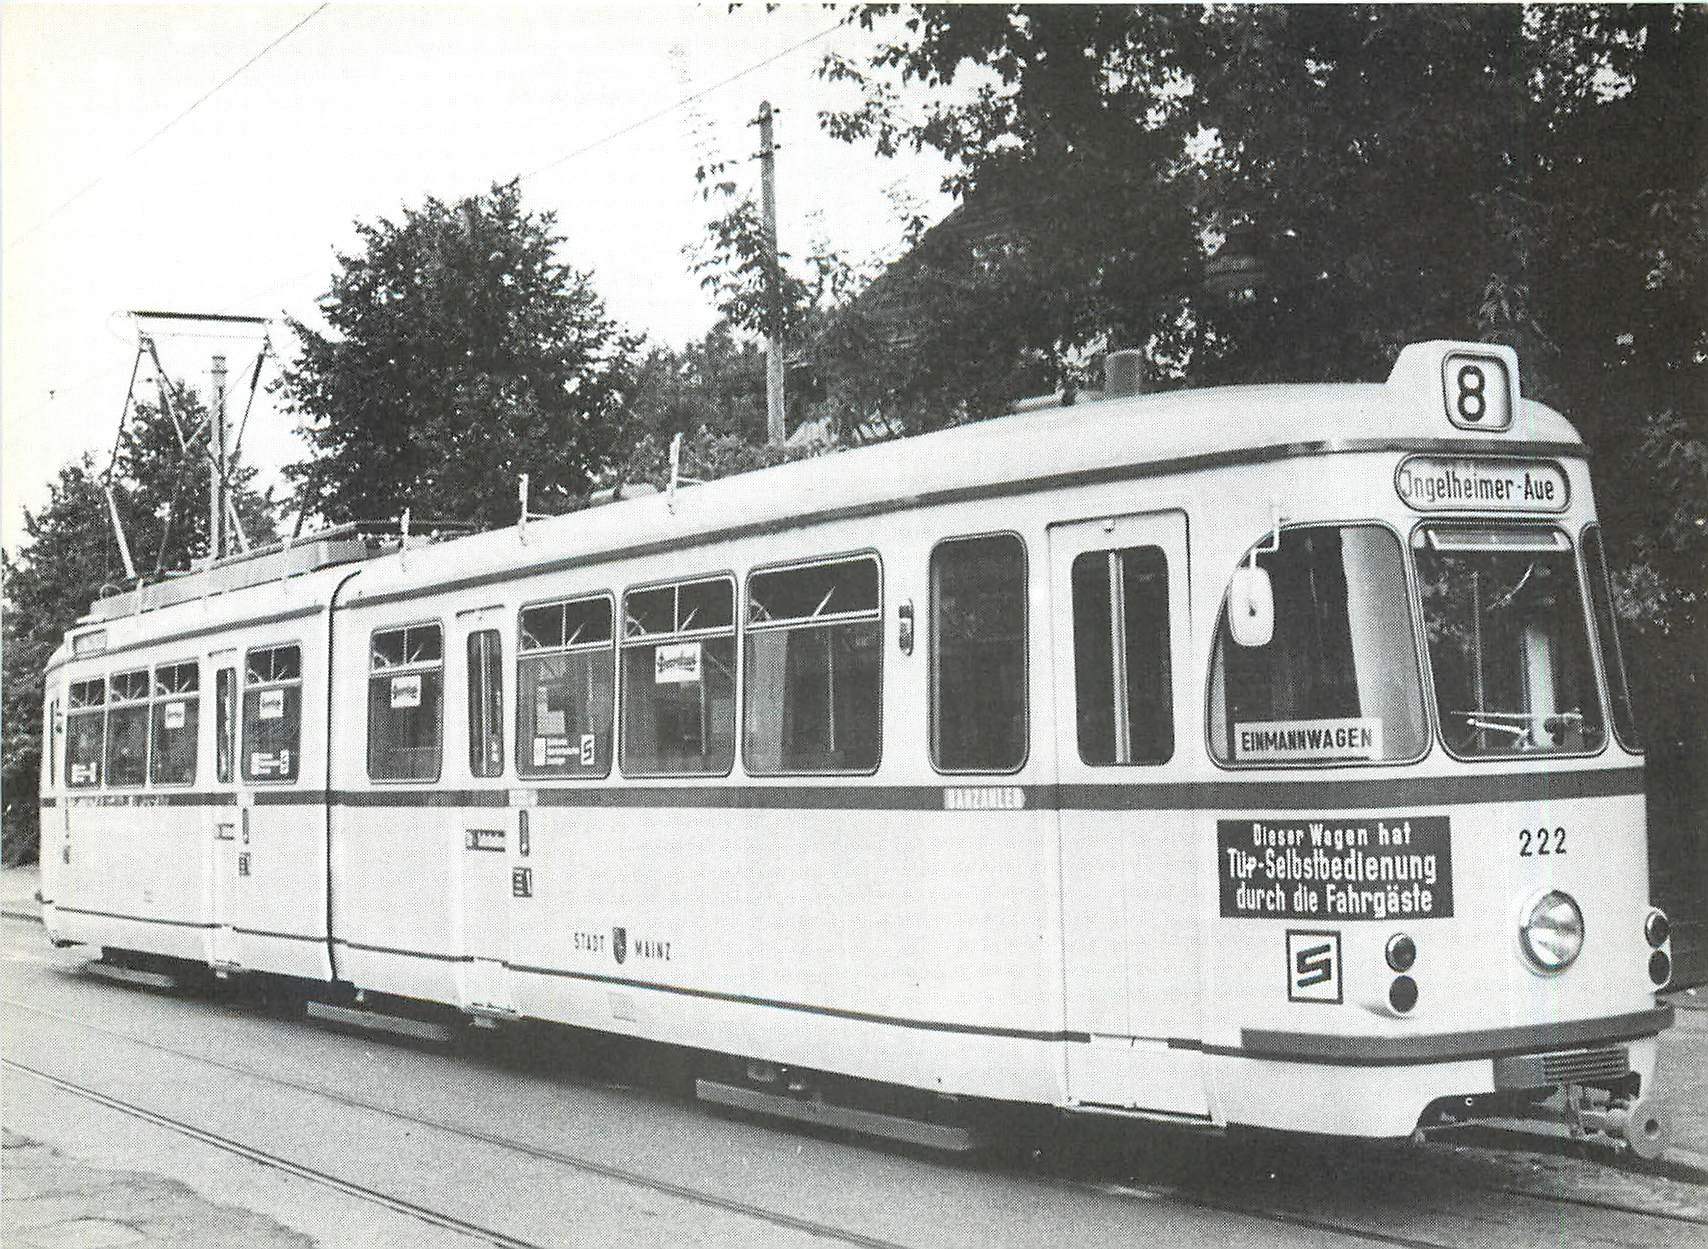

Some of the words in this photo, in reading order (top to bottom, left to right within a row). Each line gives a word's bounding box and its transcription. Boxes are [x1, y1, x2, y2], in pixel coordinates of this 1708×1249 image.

[1457, 365, 1486, 422] 8
[1241, 727, 1372, 752] EINMANNWAGEN
[1253, 823, 1304, 847] Dieser
[1309, 823, 1368, 850] Wagen
[1378, 821, 1412, 846] hat
[1519, 826, 1567, 857] 222
[1227, 847, 1437, 884] Tür-Selbstbedienung
[1236, 881, 1286, 911] durch
[1293, 883, 1319, 912] die
[1326, 882, 1433, 918] Fahrgäste
[574, 931, 605, 953] STADT
[634, 939, 672, 961] MAINZ
